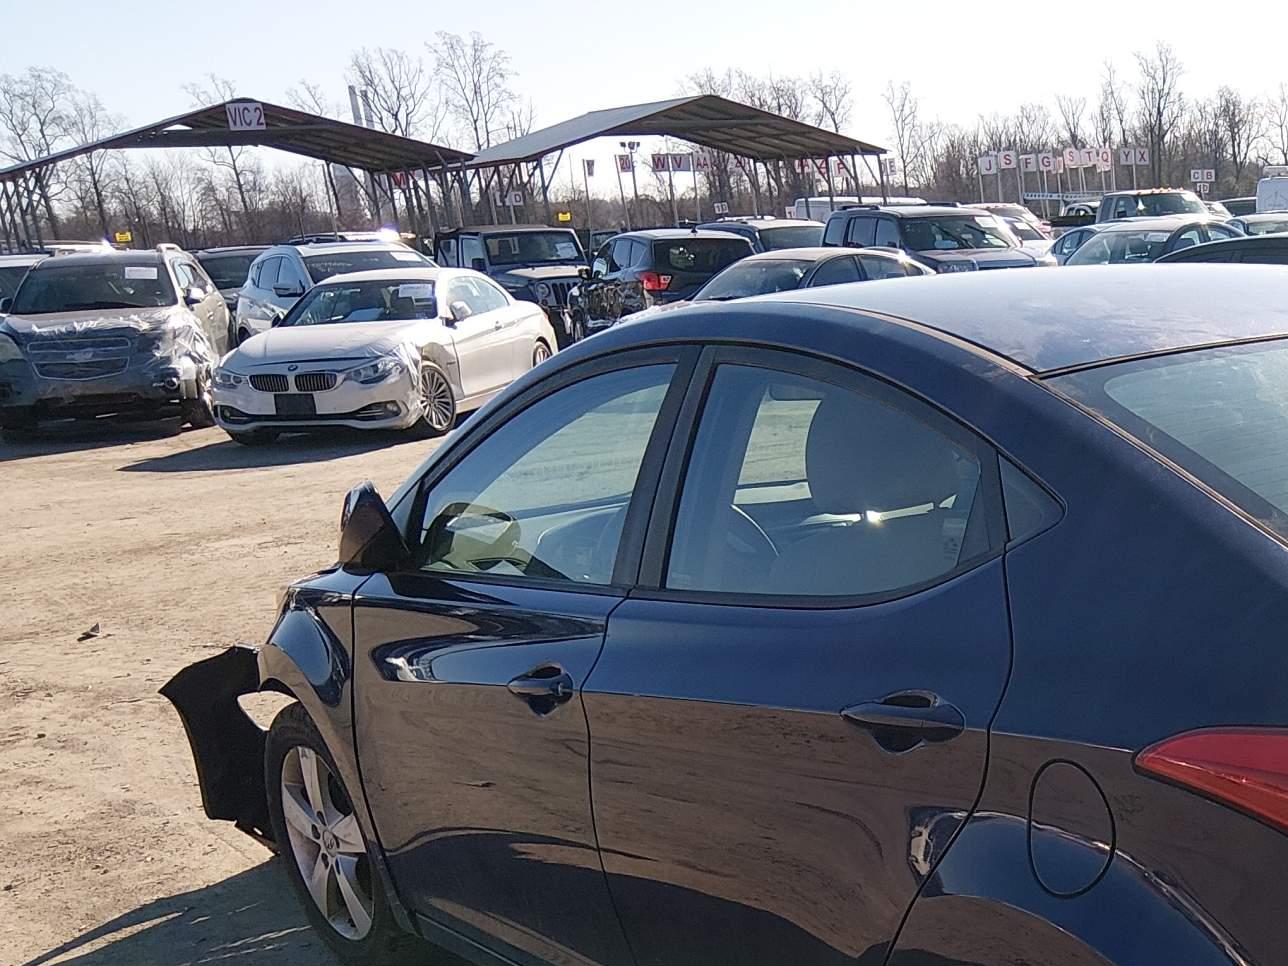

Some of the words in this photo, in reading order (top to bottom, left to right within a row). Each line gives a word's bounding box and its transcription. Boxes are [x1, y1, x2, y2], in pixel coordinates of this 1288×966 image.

[227, 106, 253, 127] VIC
[254, 106, 265, 126] 2
[1003, 153, 1012, 166] S
[1041, 155, 1052, 168] G
[1068, 150, 1075, 162] S
[1084, 151, 1094, 163] T
[1101, 151, 1110, 164] Q
[1122, 150, 1131, 163] Y
[1138, 150, 1147, 163] X
[652, 157, 666, 169] W
[674, 157, 683, 169] V
[985, 159, 993, 171] J
[1024, 157, 1032, 169] F
[1193, 171, 1200, 180] C
[1205, 171, 1214, 180] B
